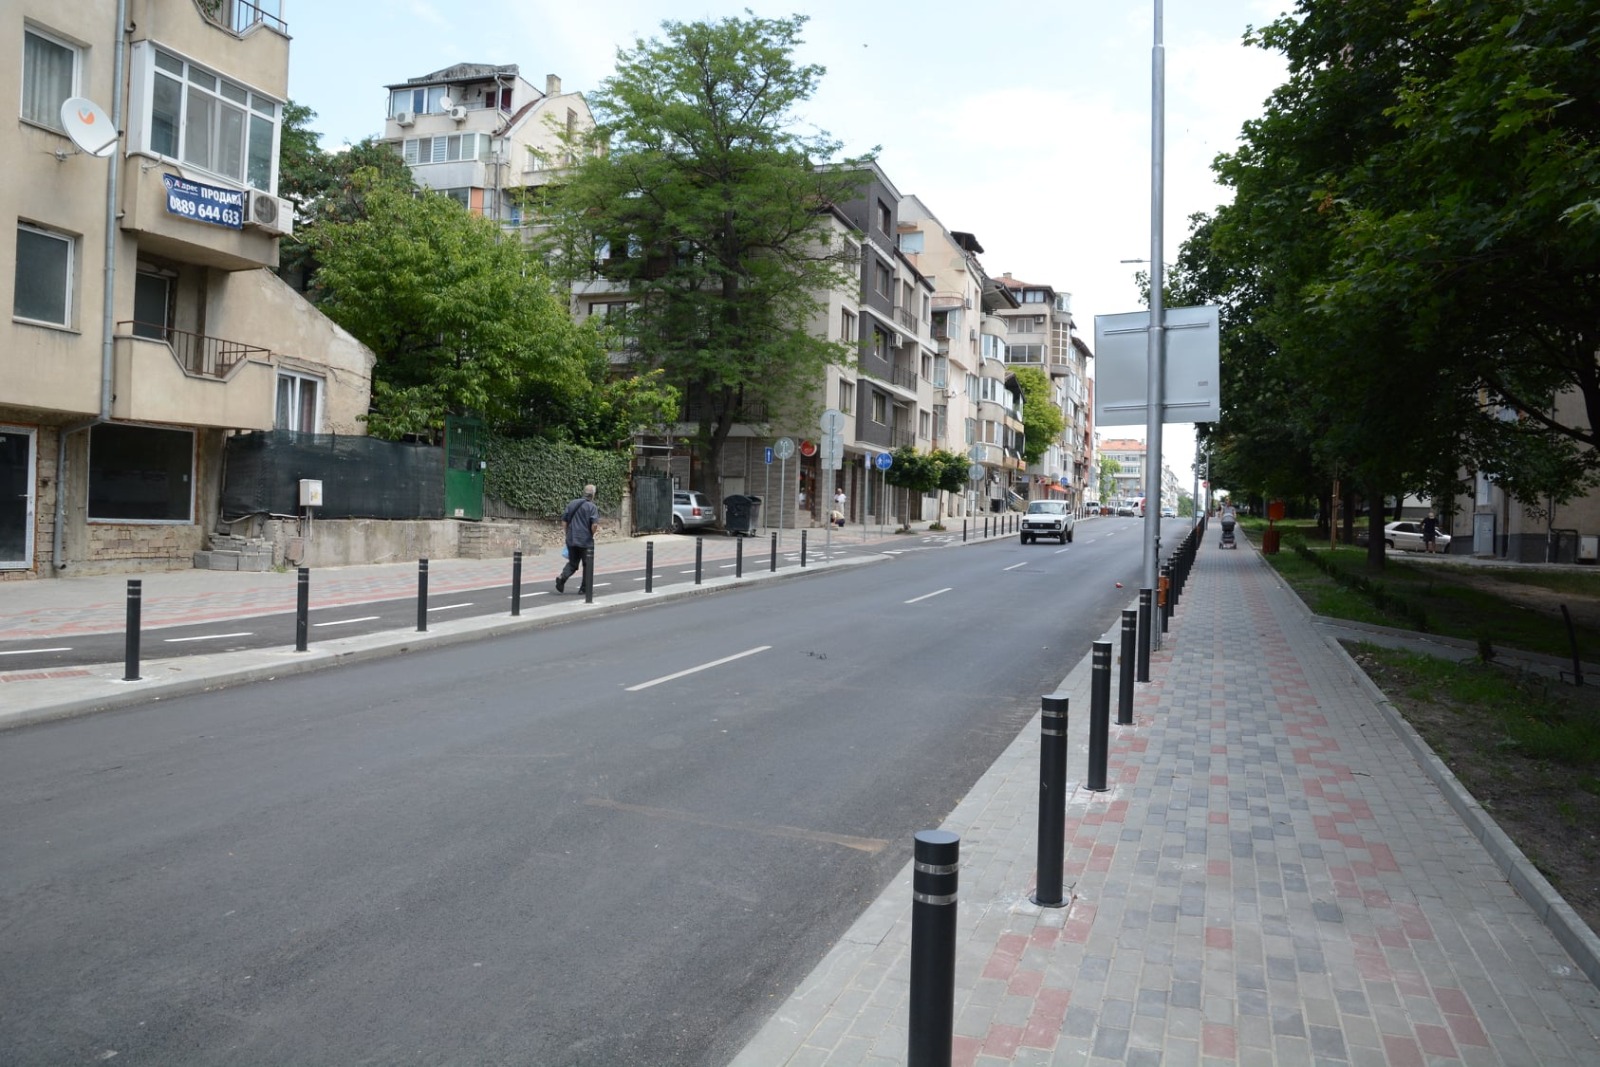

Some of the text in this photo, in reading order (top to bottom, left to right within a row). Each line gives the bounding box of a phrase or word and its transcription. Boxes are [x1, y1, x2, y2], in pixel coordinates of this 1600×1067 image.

[169, 195, 240, 225] 0889 644 633
